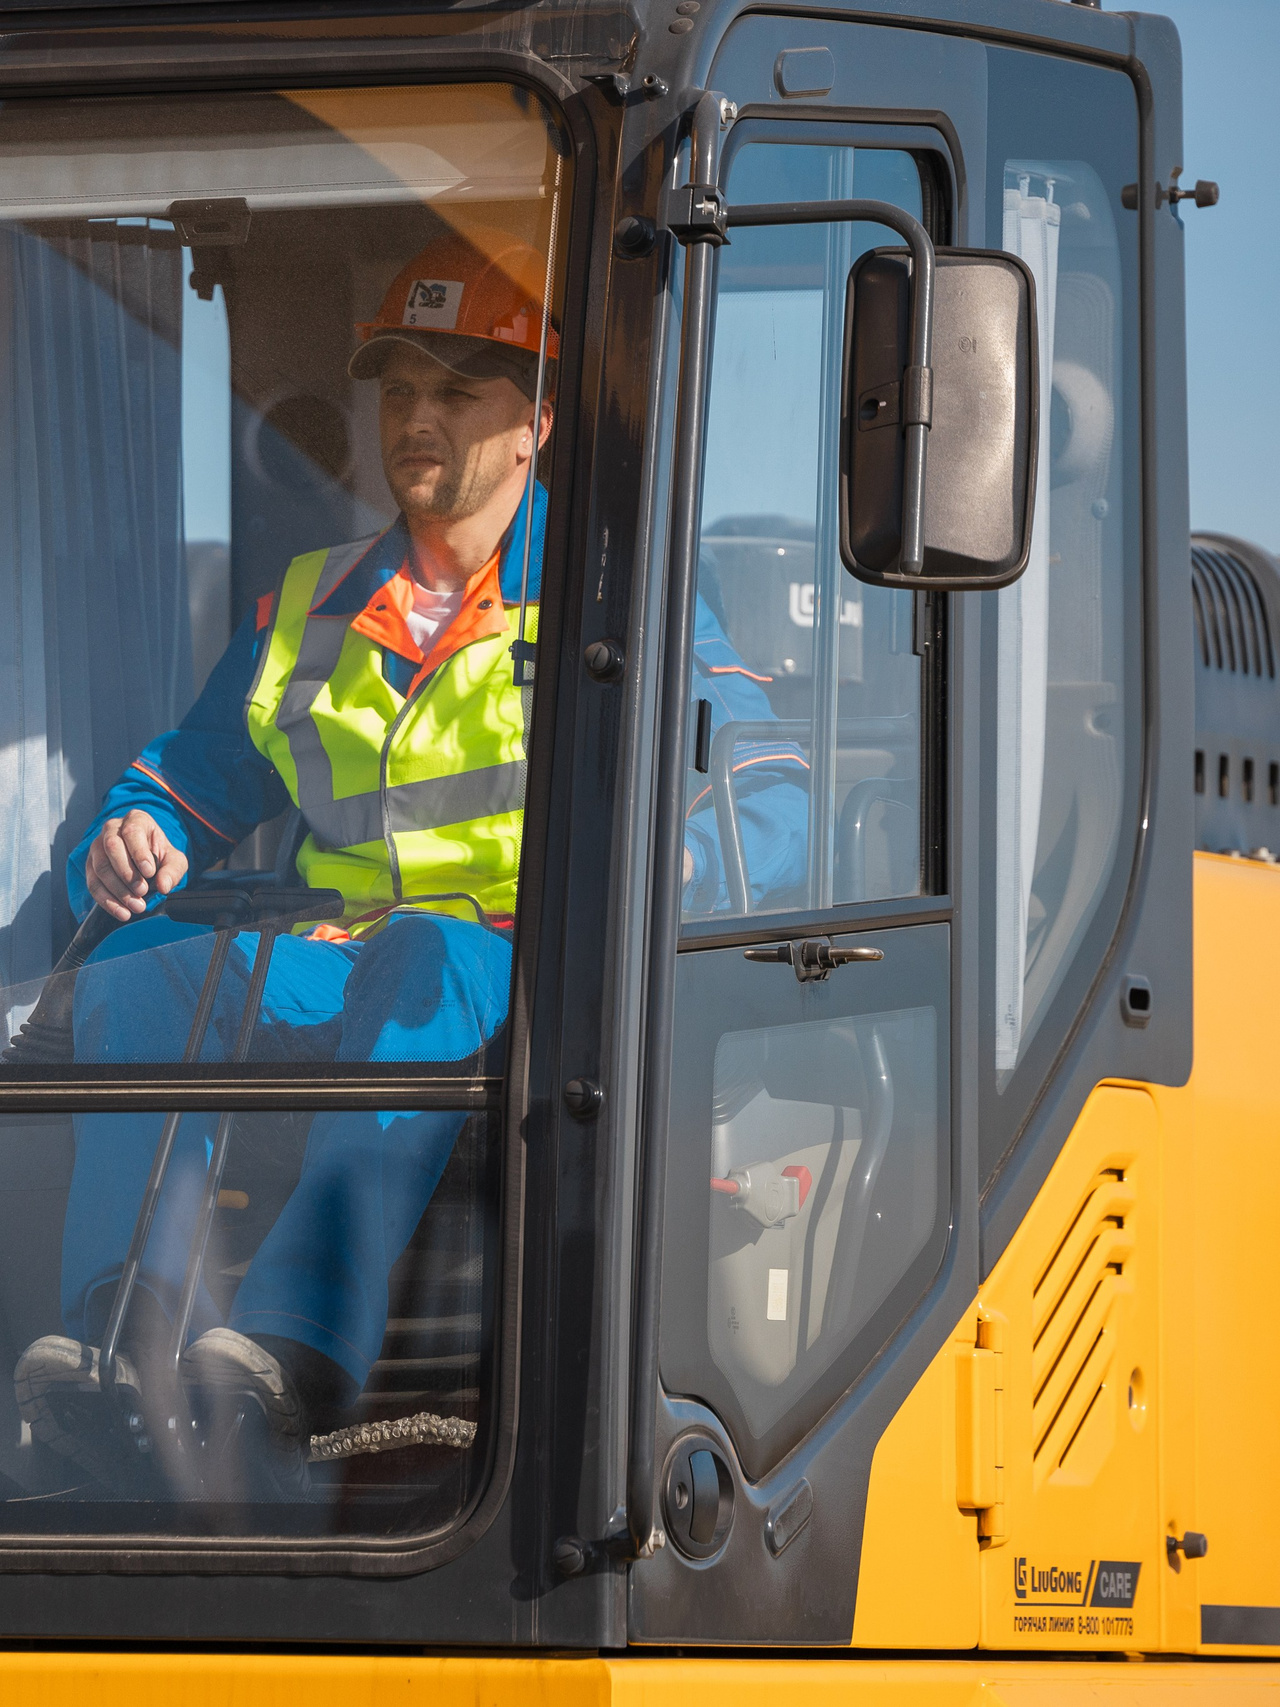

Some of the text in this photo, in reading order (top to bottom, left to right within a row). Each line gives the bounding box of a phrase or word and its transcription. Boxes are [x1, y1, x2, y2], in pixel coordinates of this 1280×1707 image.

[409, 314, 417, 324] 5
[1099, 1571, 1132, 1599] CARE
[1014, 1616, 1133, 1636] ГОРЯЧАЯ ЛИНИЯ 8-800 1017779
